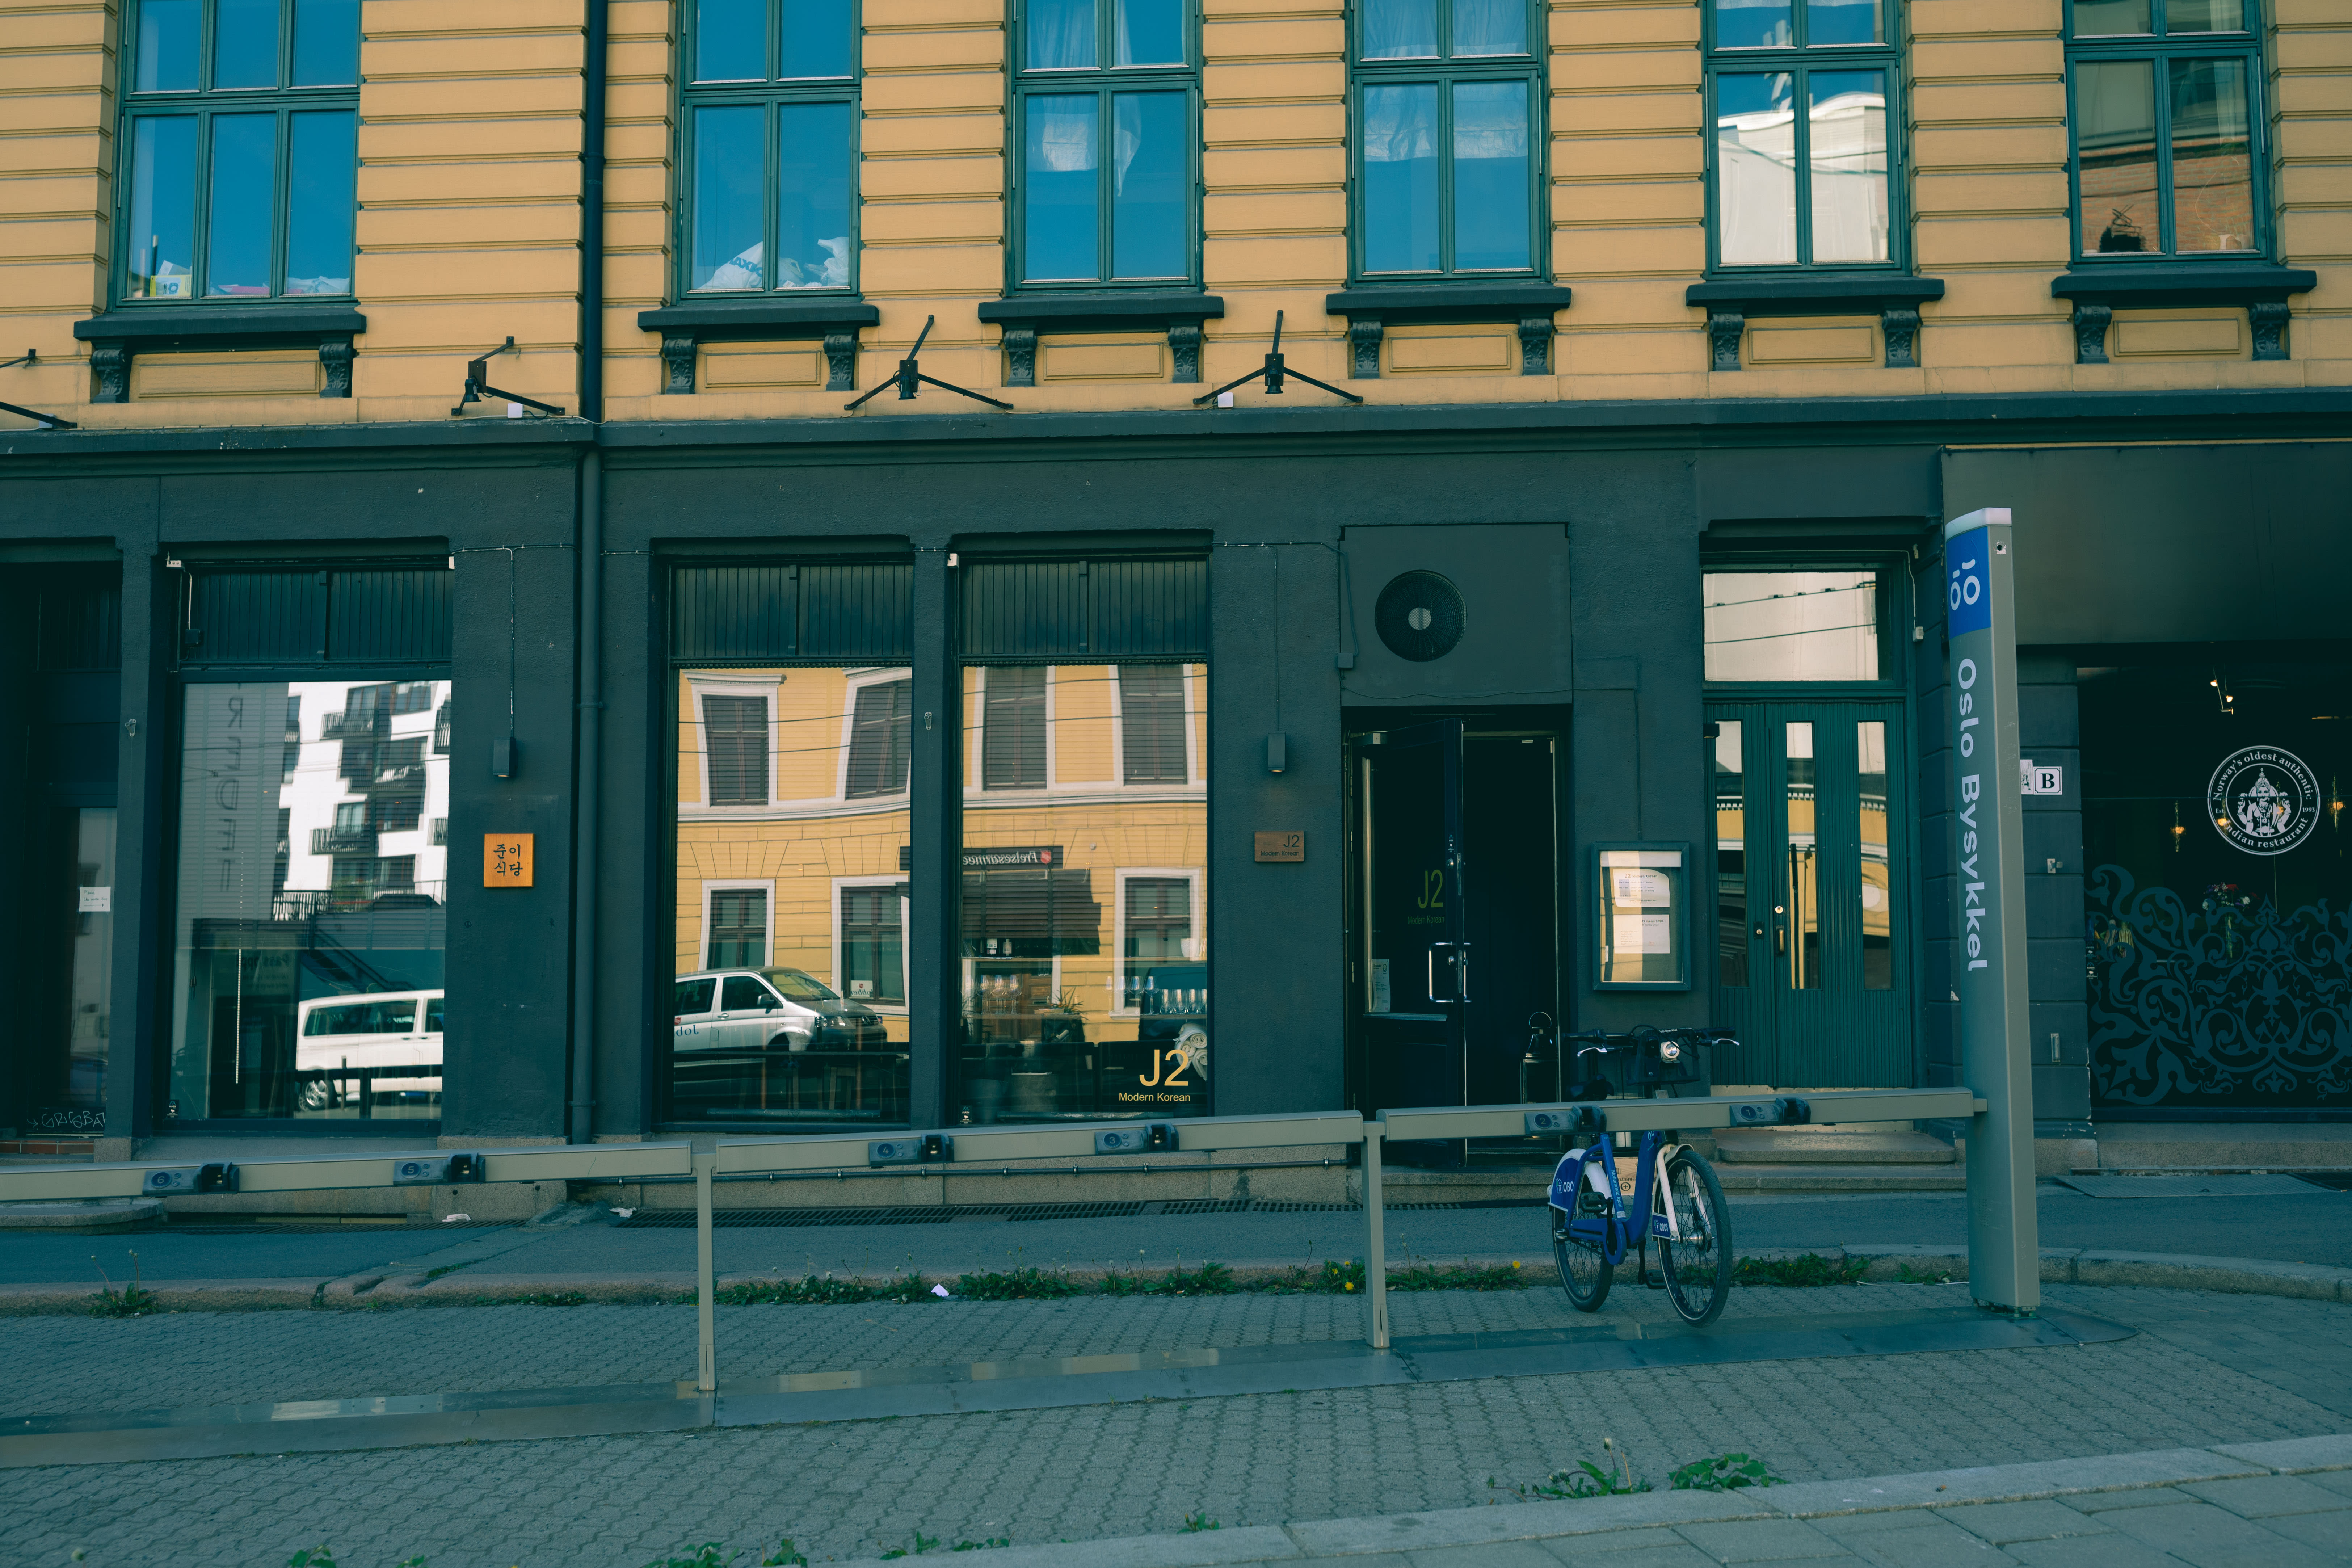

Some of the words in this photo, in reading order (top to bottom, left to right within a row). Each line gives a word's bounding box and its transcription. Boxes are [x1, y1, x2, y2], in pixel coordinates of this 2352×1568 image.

[1958, 658, 1979, 757] Oslo
[2040, 773, 2055, 789] B
[2244, 751, 2277, 762] oldest
[2279, 757, 2313, 800] authentic
[2257, 817, 2308, 848] restaurant
[1283, 835, 1300, 847] J2
[493, 844, 521, 859] 준이
[493, 862, 523, 877] 식당
[1959, 774, 1987, 971] Bysykkel
[1418, 869, 1443, 909] J2
[1427, 915, 1444, 924] Korean
[1139, 1049, 1188, 1086] J2
[1119, 1092, 1154, 1101] Modern
[1157, 1092, 1190, 1101] Korean
[408, 1166, 415, 1174] 5
[157, 1176, 165, 1184] 6
[1659, 1223, 1669, 1232] OBOS
